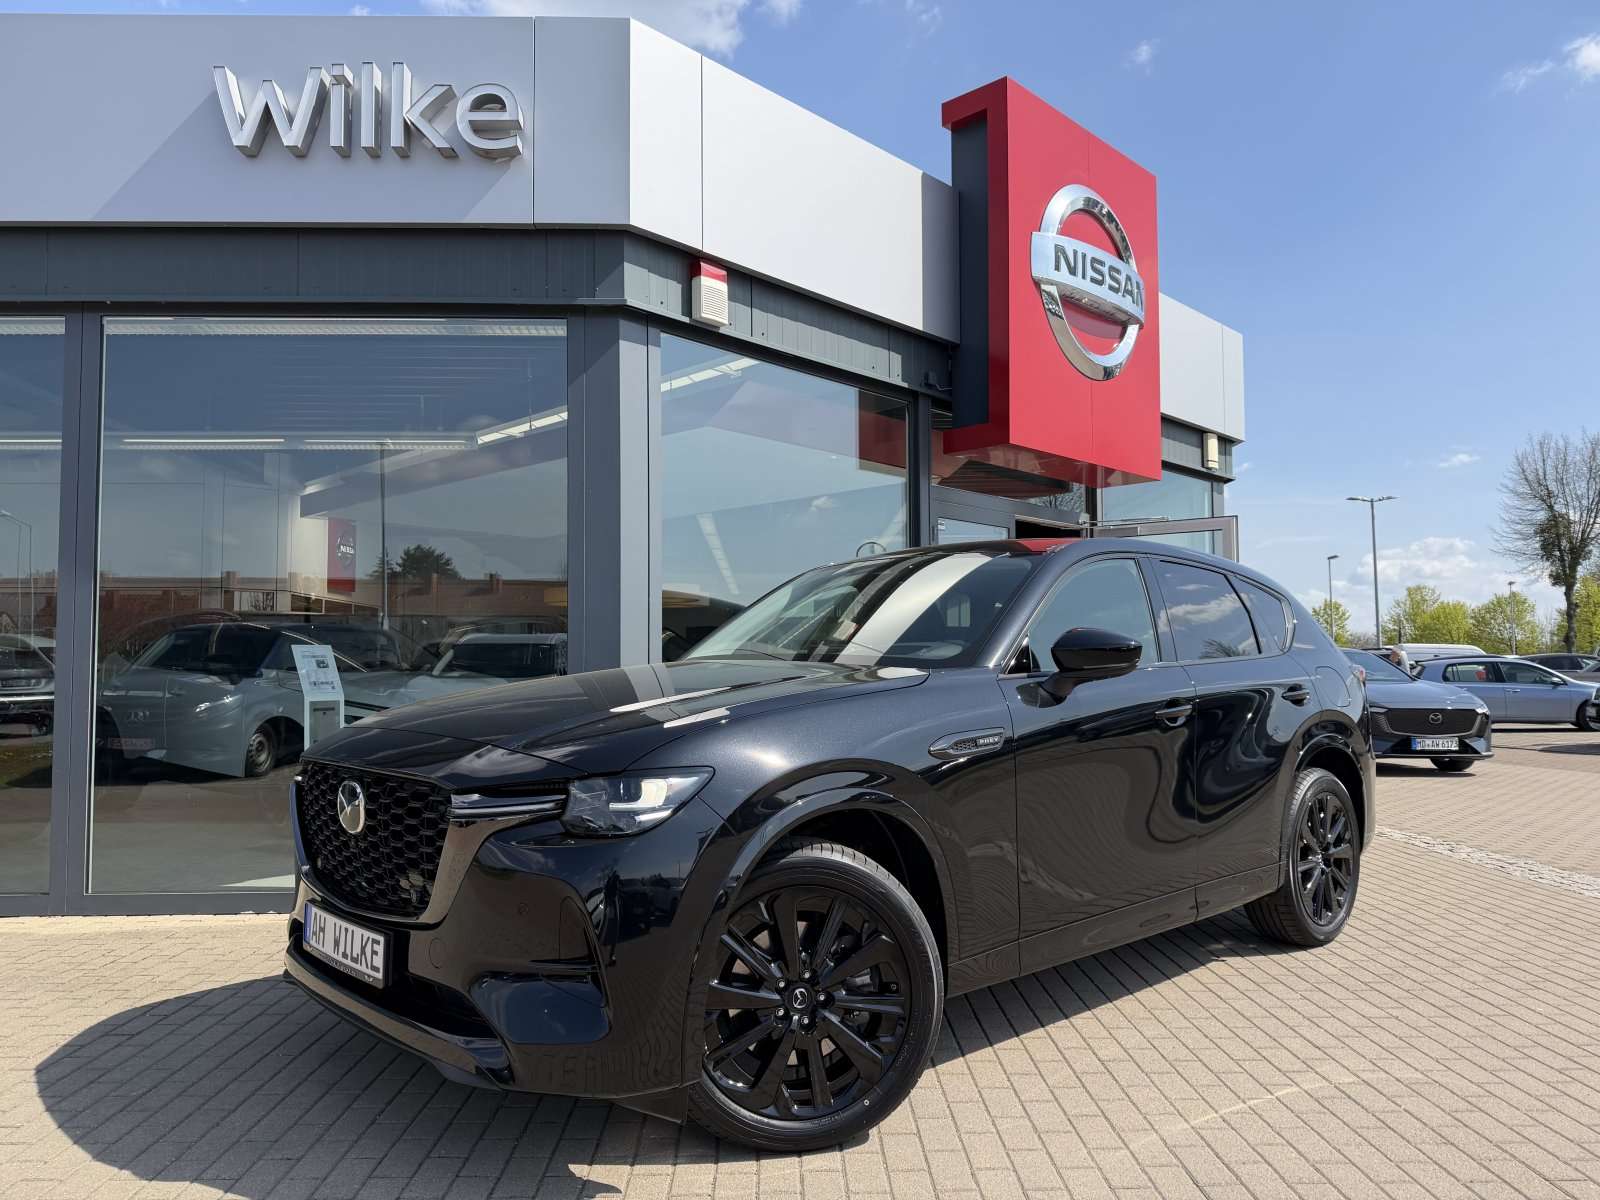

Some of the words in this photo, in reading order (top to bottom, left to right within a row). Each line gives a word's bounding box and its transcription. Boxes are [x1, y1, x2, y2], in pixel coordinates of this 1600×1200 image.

[1054, 243, 1143, 312] NISSAN
[311, 911, 327, 949] AH
[333, 921, 381, 973] WILKE
